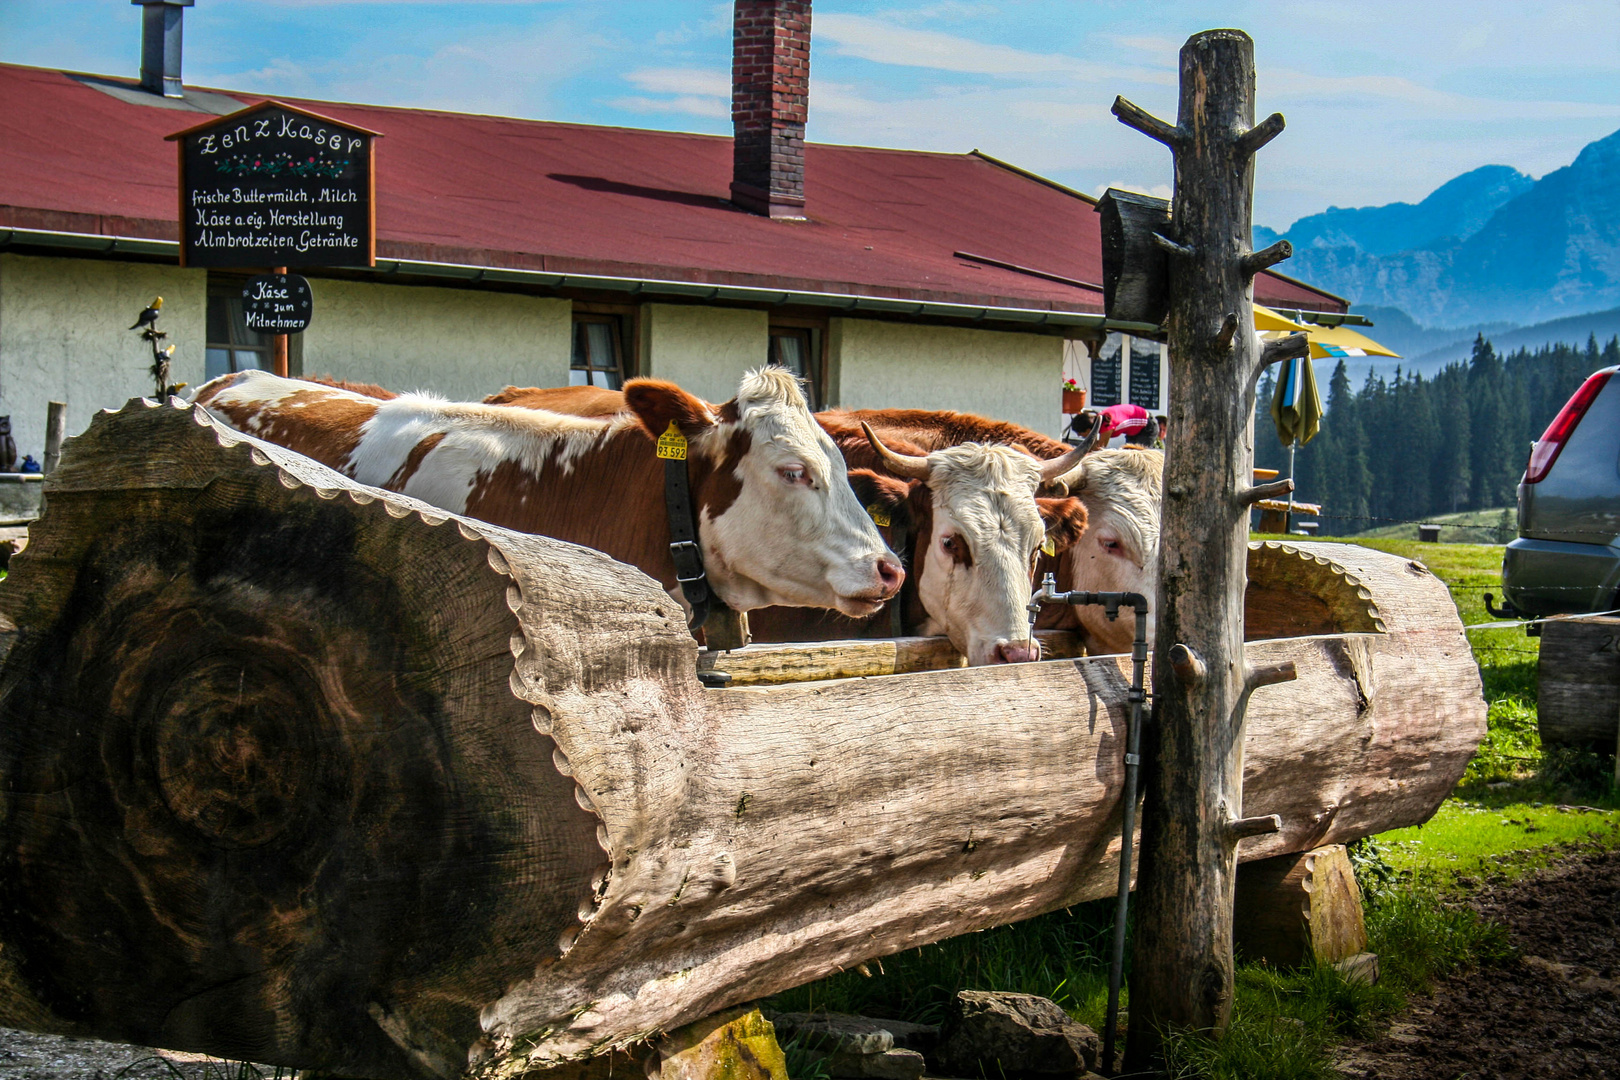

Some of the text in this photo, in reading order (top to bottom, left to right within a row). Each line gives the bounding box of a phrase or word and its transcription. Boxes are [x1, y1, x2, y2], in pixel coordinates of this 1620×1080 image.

[277, 115, 361, 153] Kaser
[192, 189, 230, 206] frische
[318, 188, 357, 203] Milch
[196, 208, 231, 226] Käse
[269, 208, 344, 229] Herstellung
[295, 229, 358, 252] Getränke
[252, 281, 289, 300] Käse
[274, 303, 294, 312] zum
[246, 311, 305, 328] Mitnehmen
[658, 446, 686, 459] 93 592
